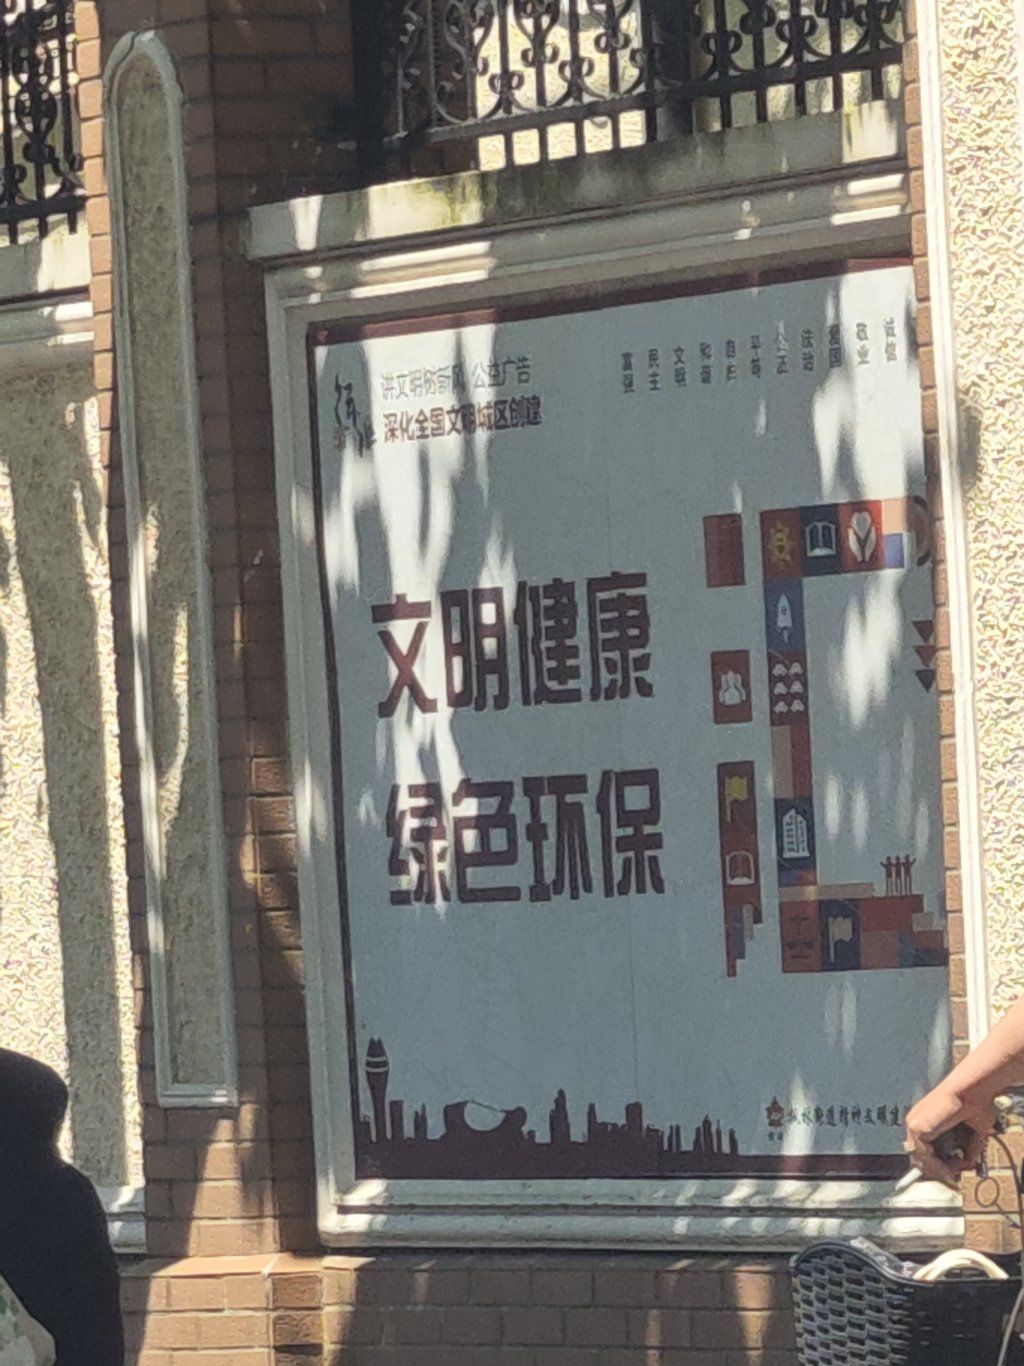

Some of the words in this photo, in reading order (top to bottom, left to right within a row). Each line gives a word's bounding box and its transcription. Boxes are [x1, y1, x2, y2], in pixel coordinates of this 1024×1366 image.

[370, 570, 656, 719] 文明健康
[386, 767, 666, 906] 绿色环保
